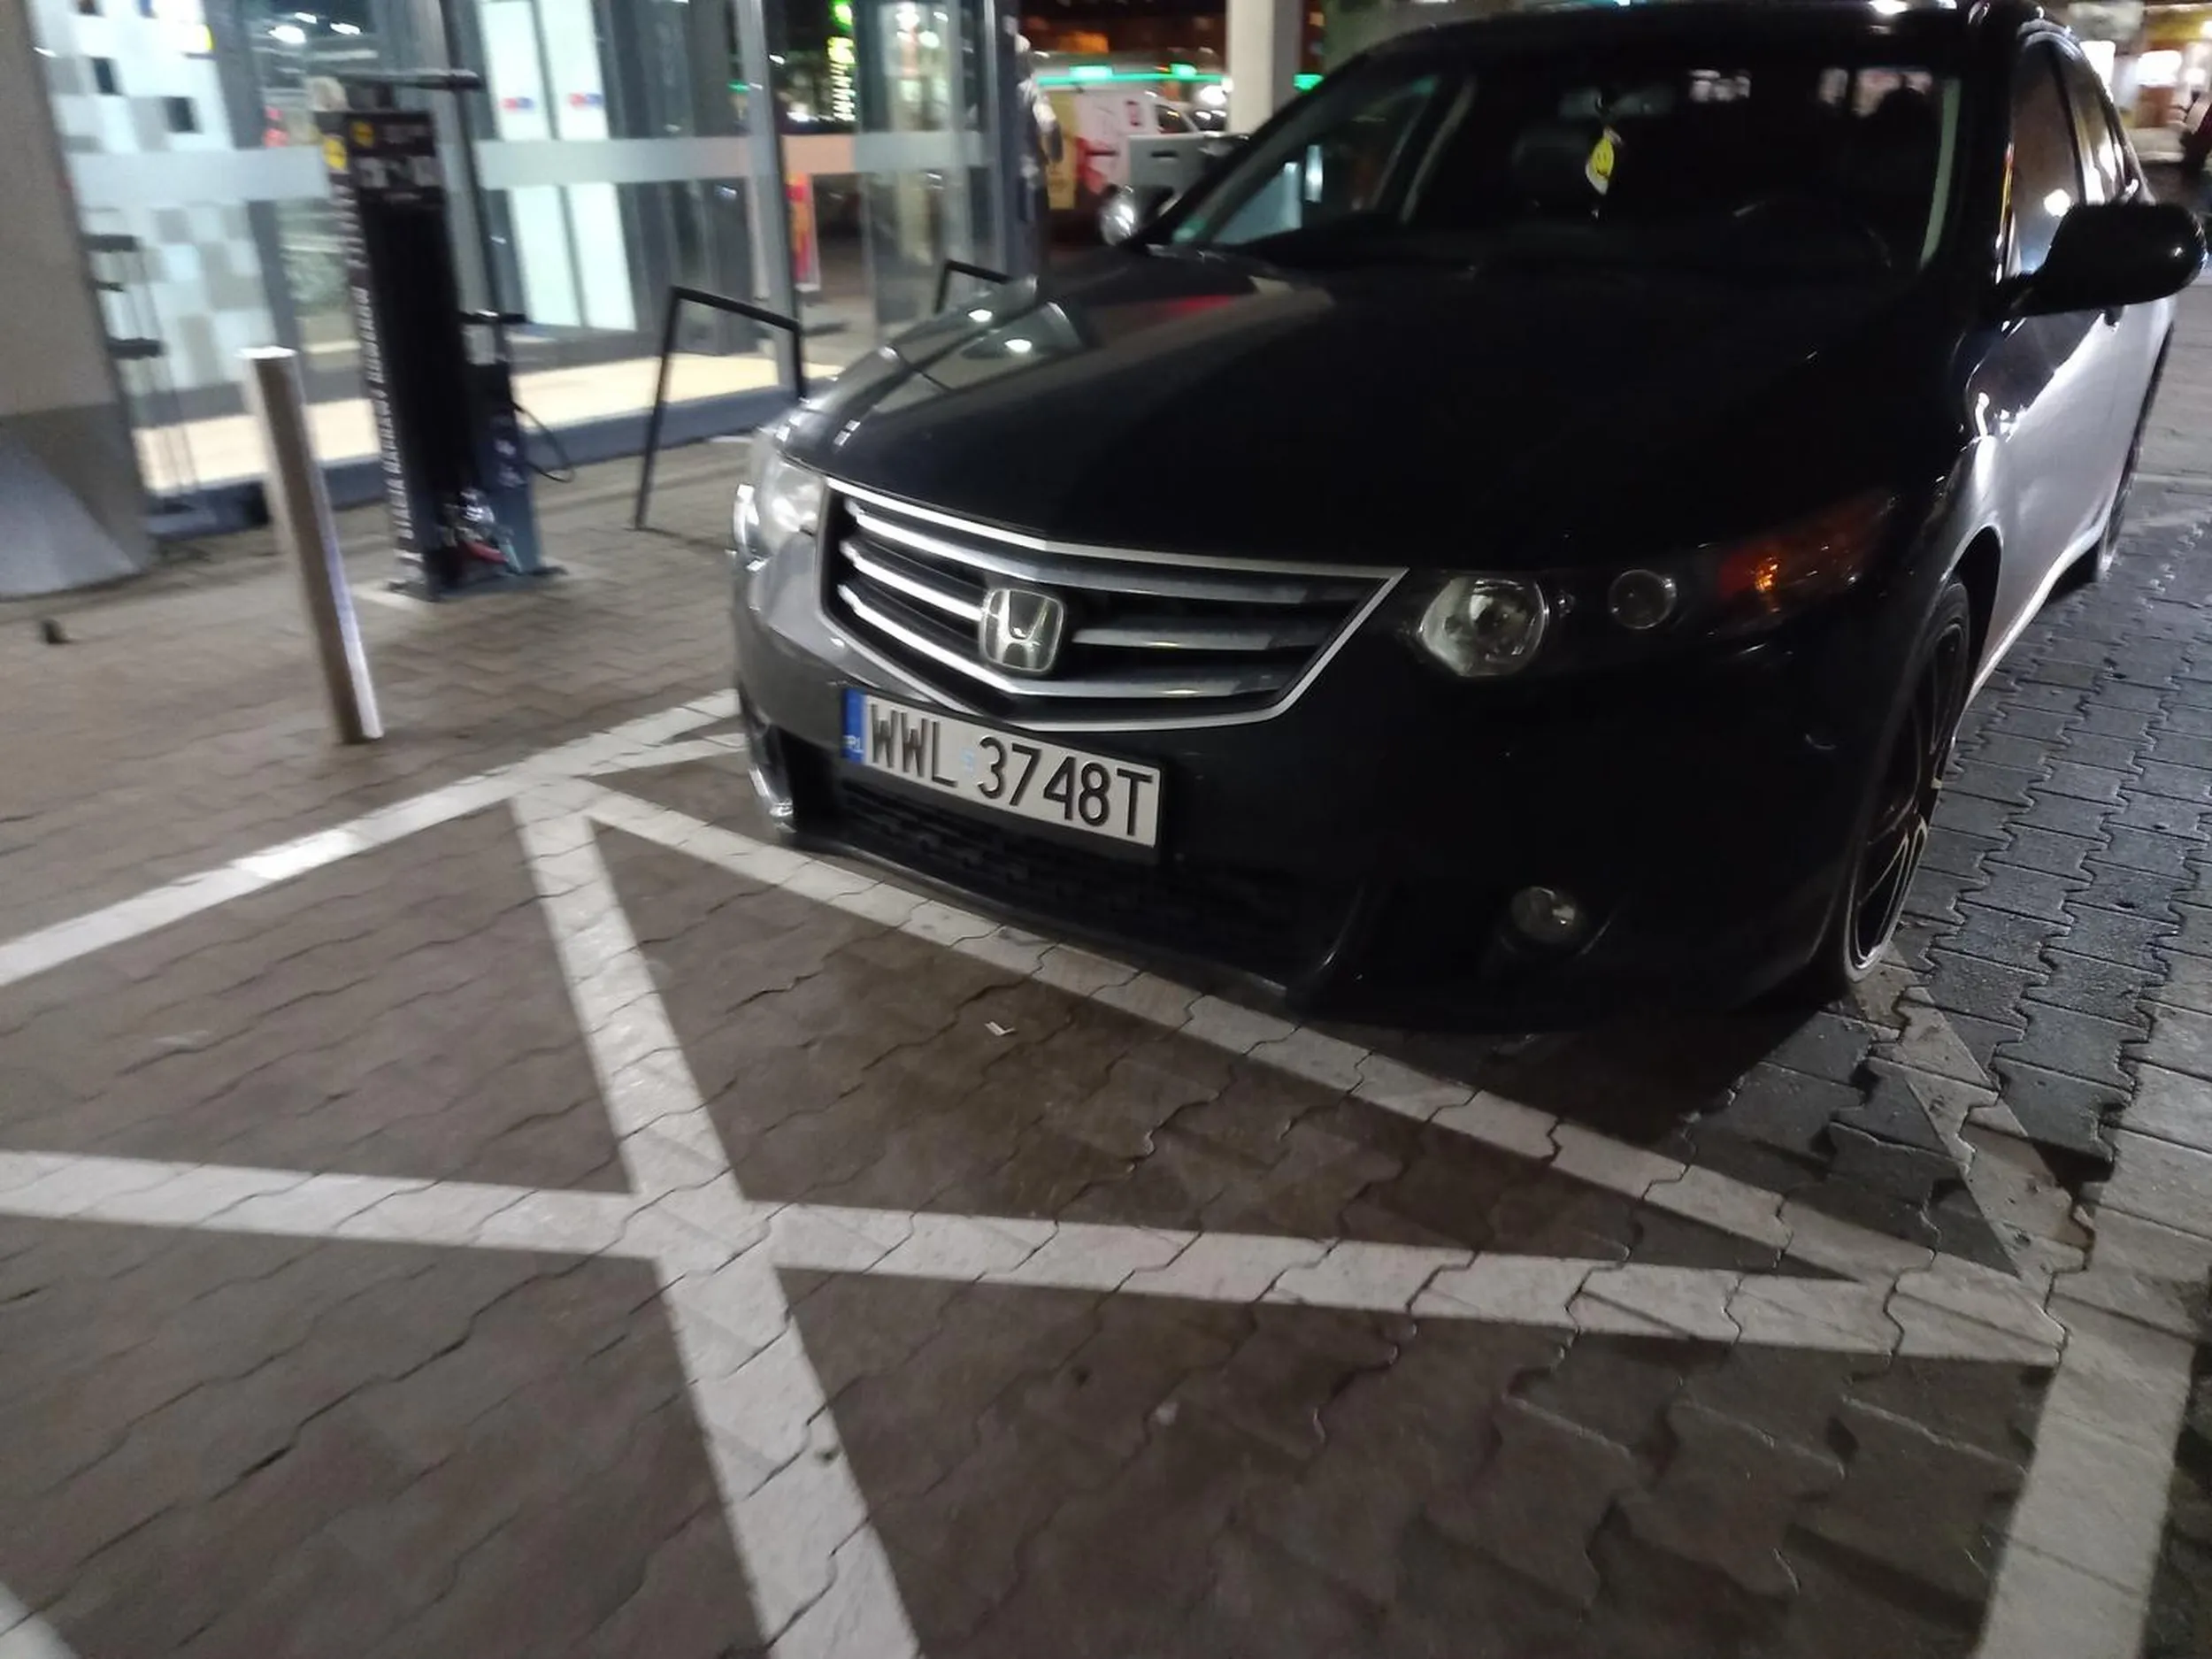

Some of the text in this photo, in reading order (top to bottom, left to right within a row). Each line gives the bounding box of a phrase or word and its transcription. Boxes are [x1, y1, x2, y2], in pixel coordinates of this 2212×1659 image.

[845, 734, 864, 754] PL
[870, 703, 1153, 836] WWL 3748T
